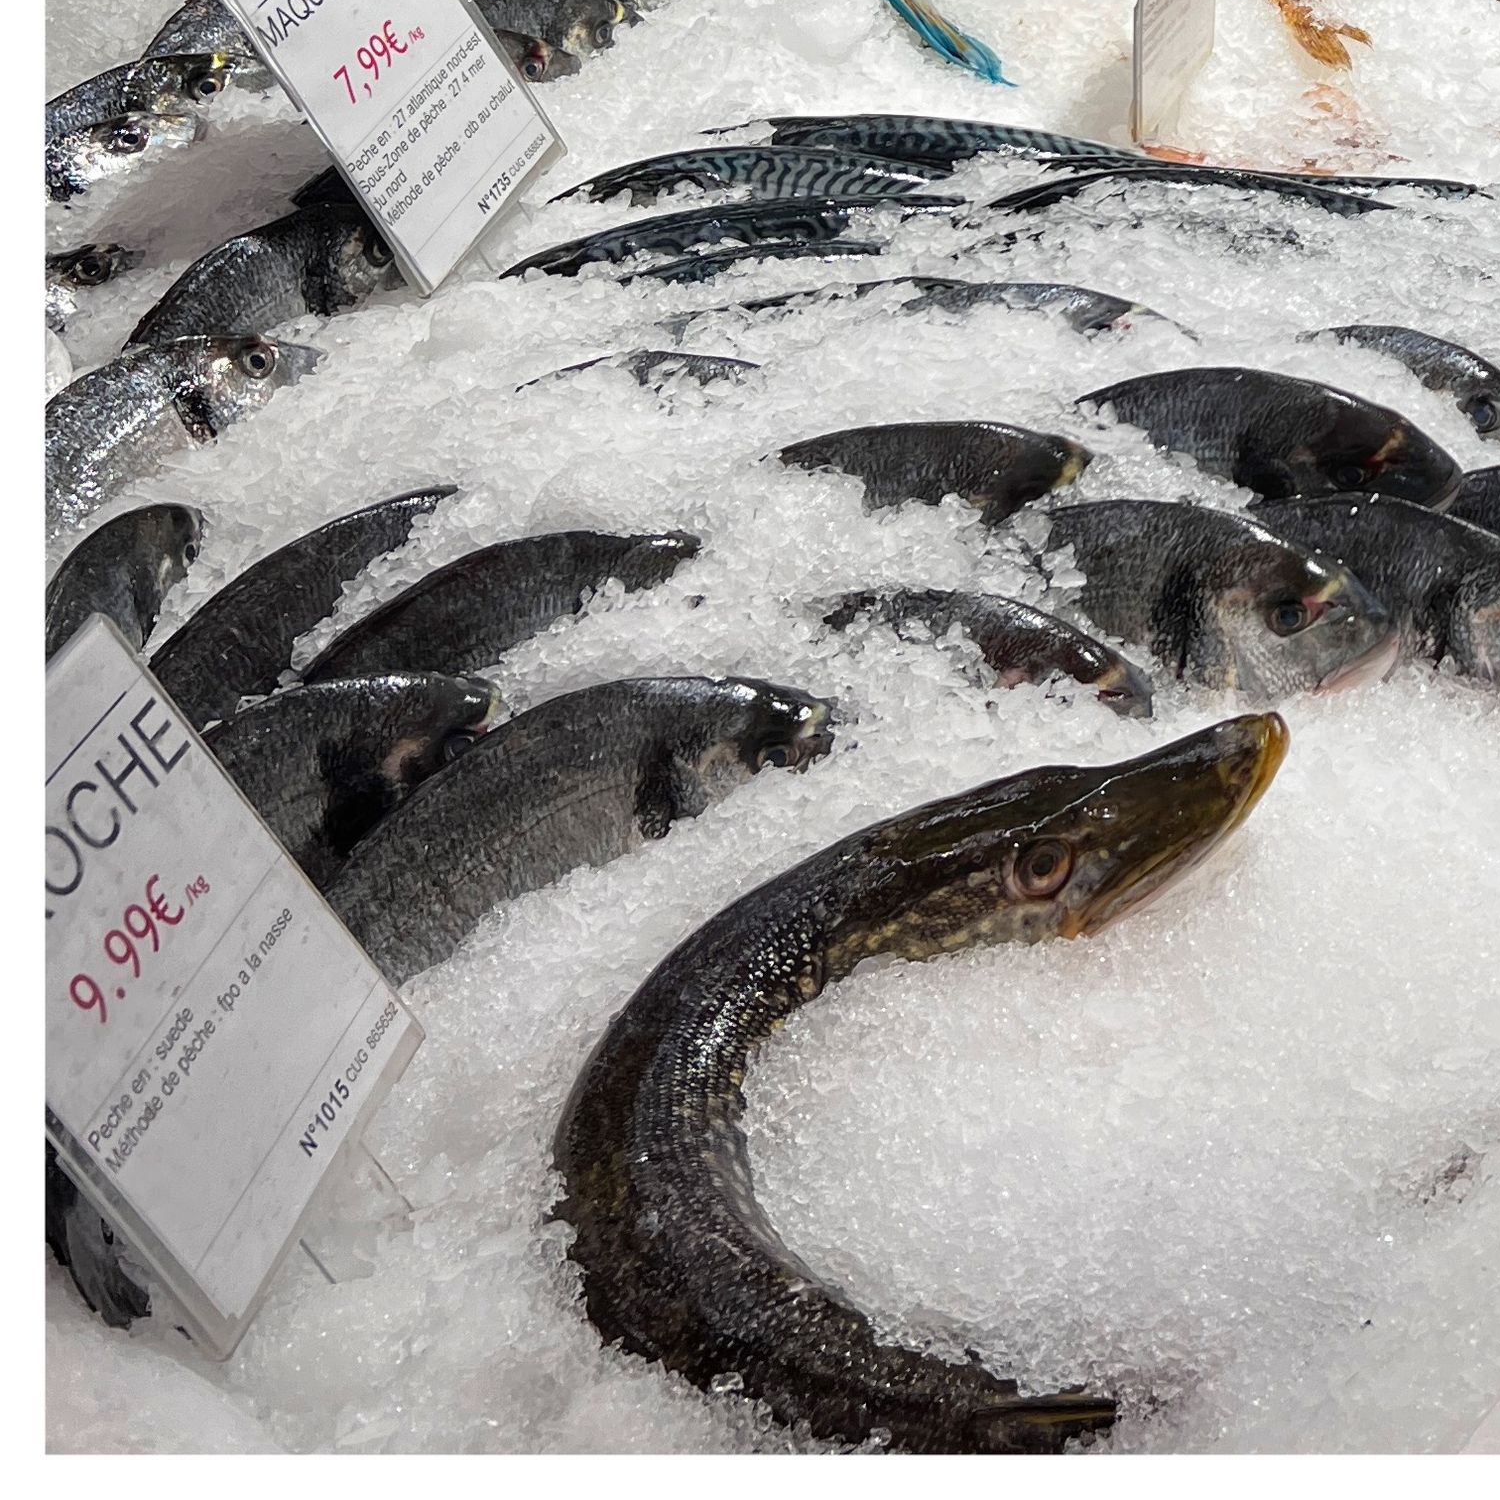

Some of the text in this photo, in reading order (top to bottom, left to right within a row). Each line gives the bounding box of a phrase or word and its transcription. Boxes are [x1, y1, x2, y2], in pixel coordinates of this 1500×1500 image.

[333, 19, 426, 105] 7,99€ /kg
[358, 140, 409, 195] Sous-Zone
[407, 125, 421, 144] de
[419, 98, 448, 136] pêche
[468, 54, 487, 77] mer
[377, 130, 392, 146] en
[446, 33, 485, 76] nord-est
[384, 78, 516, 227] Méthode de pêche otb au chalut
[386, 168, 409, 200] nord
[477, 157, 526, 215] N°1735 CUG
[44, 697, 191, 902] OCHE
[69, 873, 212, 1025] 9.99€ /kg
[87, 1007, 195, 1153] Peche en suede
[104, 907, 294, 1174] Méthode de pêche fpo a la nasse
[298, 1078, 350, 1159] N°1015
[344, 1048, 369, 1084] CUG
